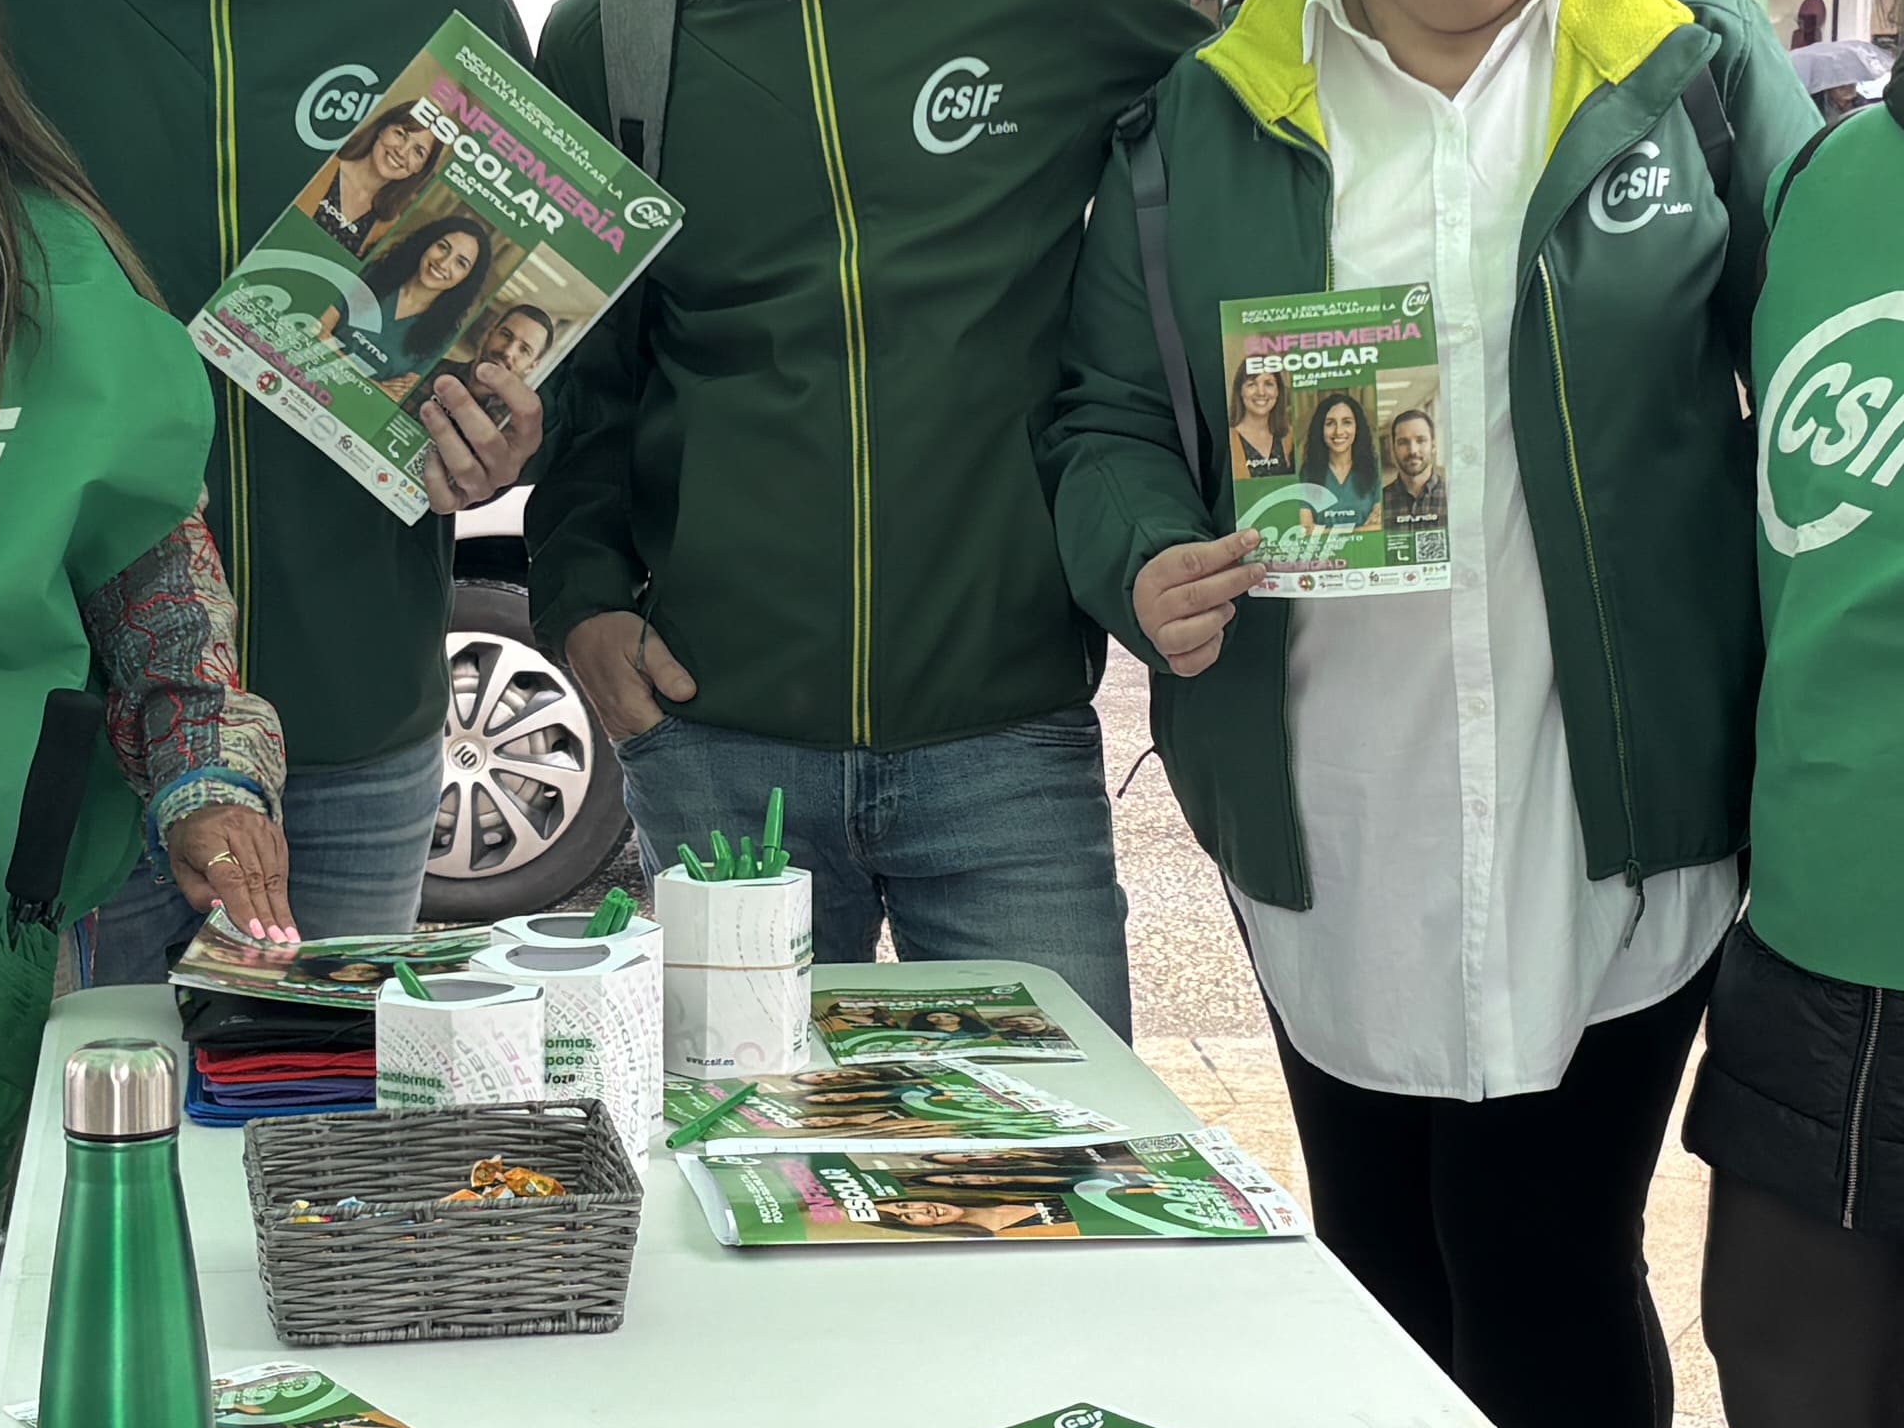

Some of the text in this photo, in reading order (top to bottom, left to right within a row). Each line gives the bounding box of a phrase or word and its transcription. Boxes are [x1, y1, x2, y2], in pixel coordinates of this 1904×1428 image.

[931, 82, 1004, 122] CSIF
[987, 118, 1019, 136] León
[409, 95, 565, 236] ESCOLAR
[428, 75, 627, 256] ENFERMERÍA
[1606, 163, 1671, 206] CSIF
[1244, 319, 1422, 355] ENFERMERÍA
[1245, 346, 1379, 376] ESCOLAR
